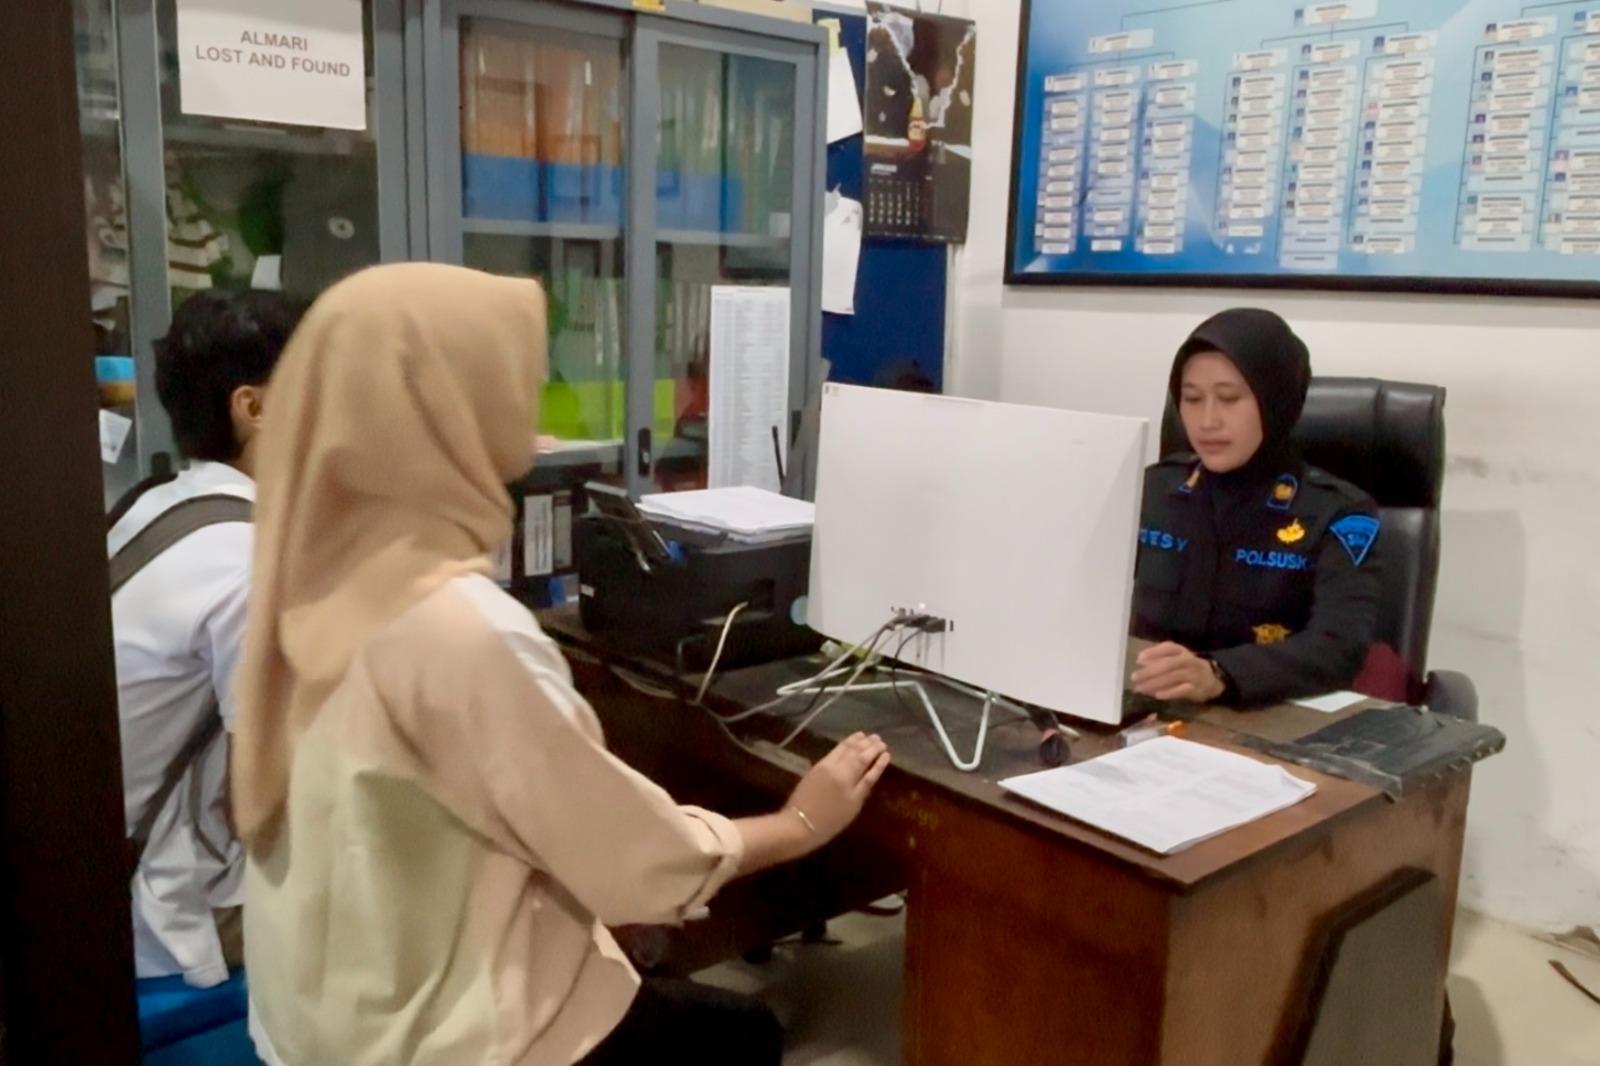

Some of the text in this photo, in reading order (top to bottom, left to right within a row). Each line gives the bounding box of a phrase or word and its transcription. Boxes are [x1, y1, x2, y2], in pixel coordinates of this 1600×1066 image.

[240, 30, 308, 51] ALMARI
[195, 45, 351, 78] LOST AND FOUND
